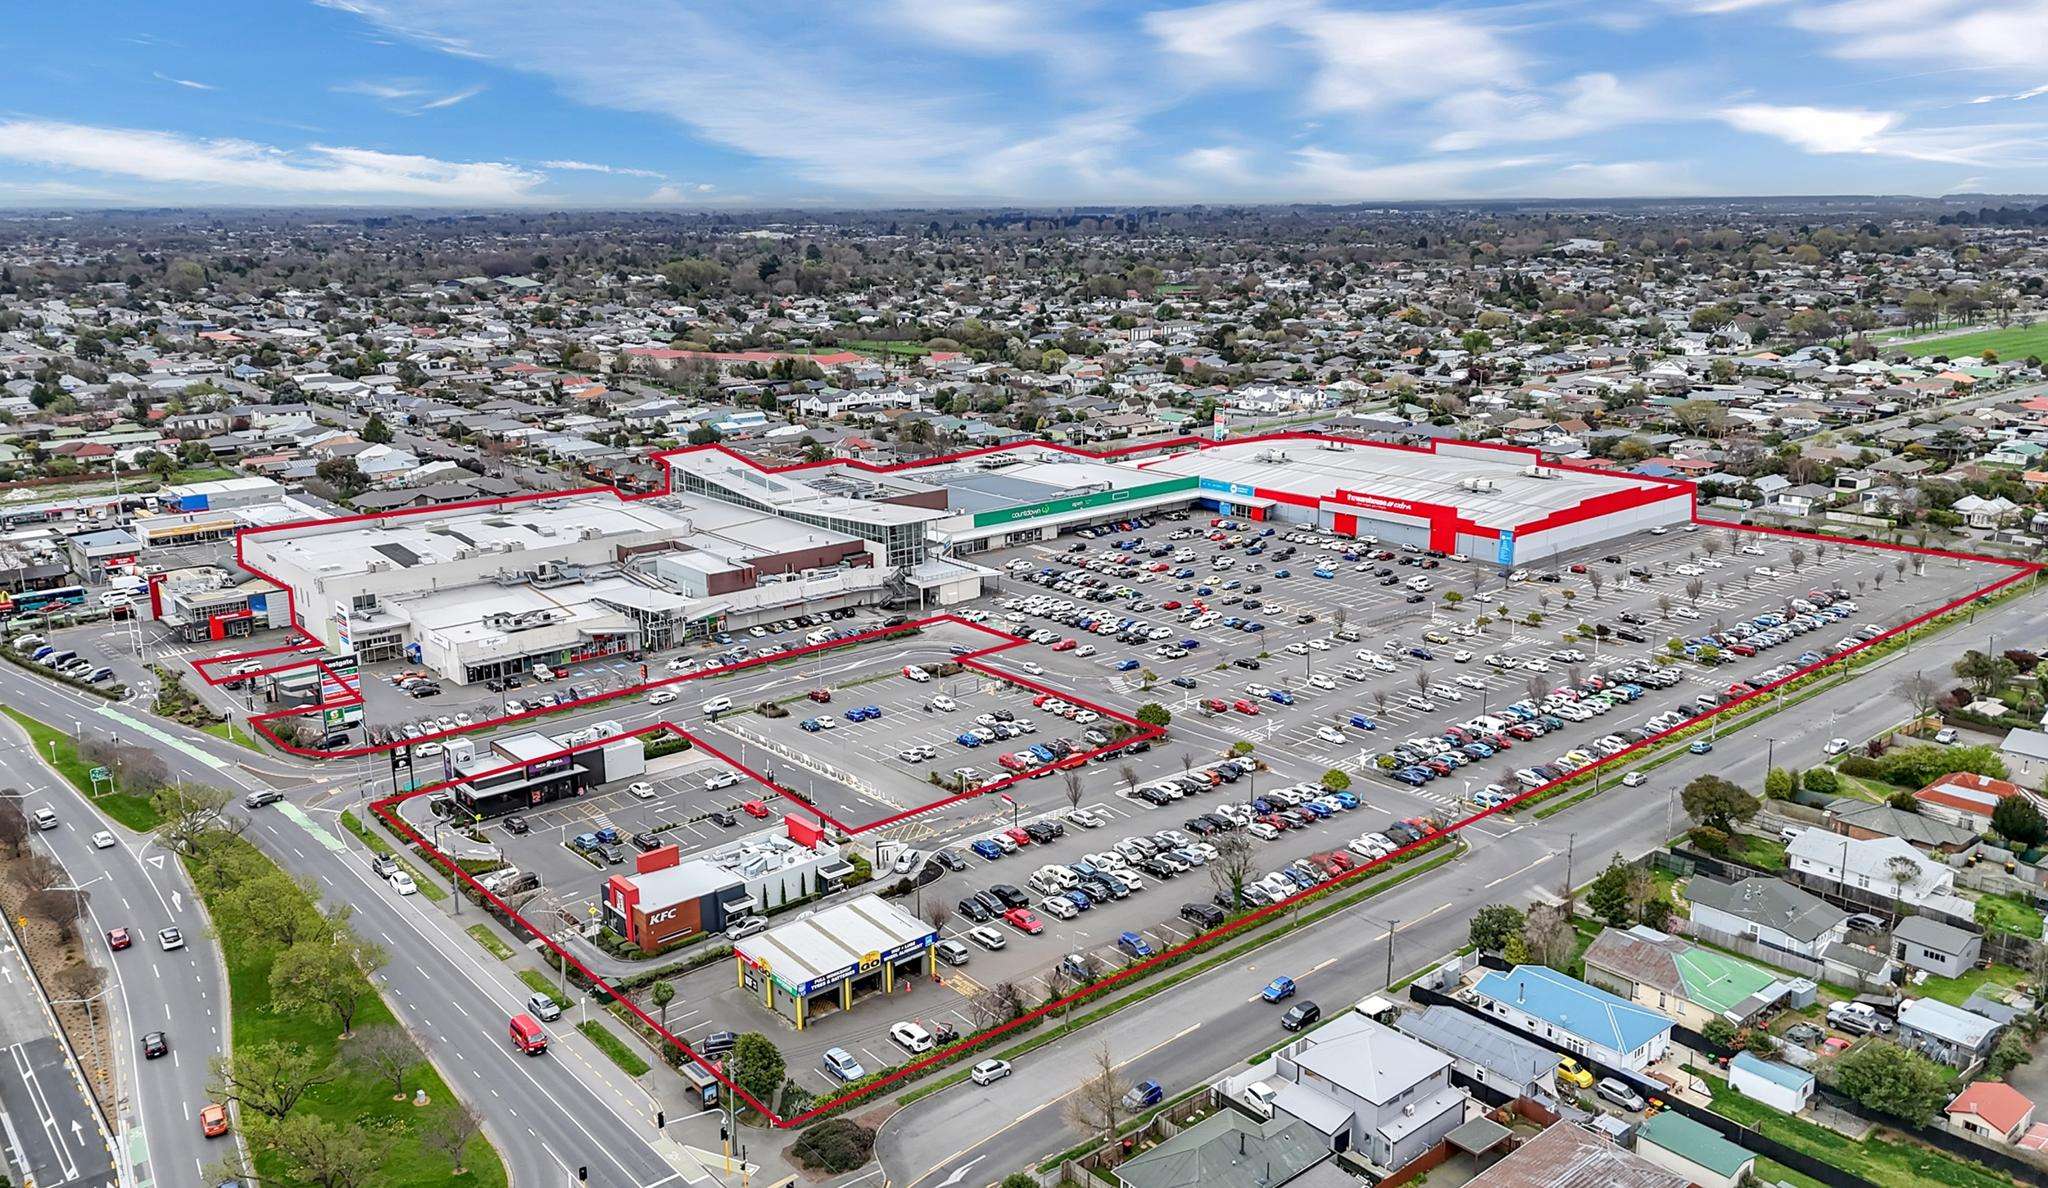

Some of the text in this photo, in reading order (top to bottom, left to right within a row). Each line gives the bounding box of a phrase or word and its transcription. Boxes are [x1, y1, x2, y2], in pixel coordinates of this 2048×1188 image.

[1011, 508, 1041, 519] countdown
[649, 908, 677, 926] KFC
[860, 959, 880, 971] GO
[811, 981, 827, 991] TYRES
[831, 969, 856, 983] BATTERIES
[826, 966, 853, 980] WORKSHOP
